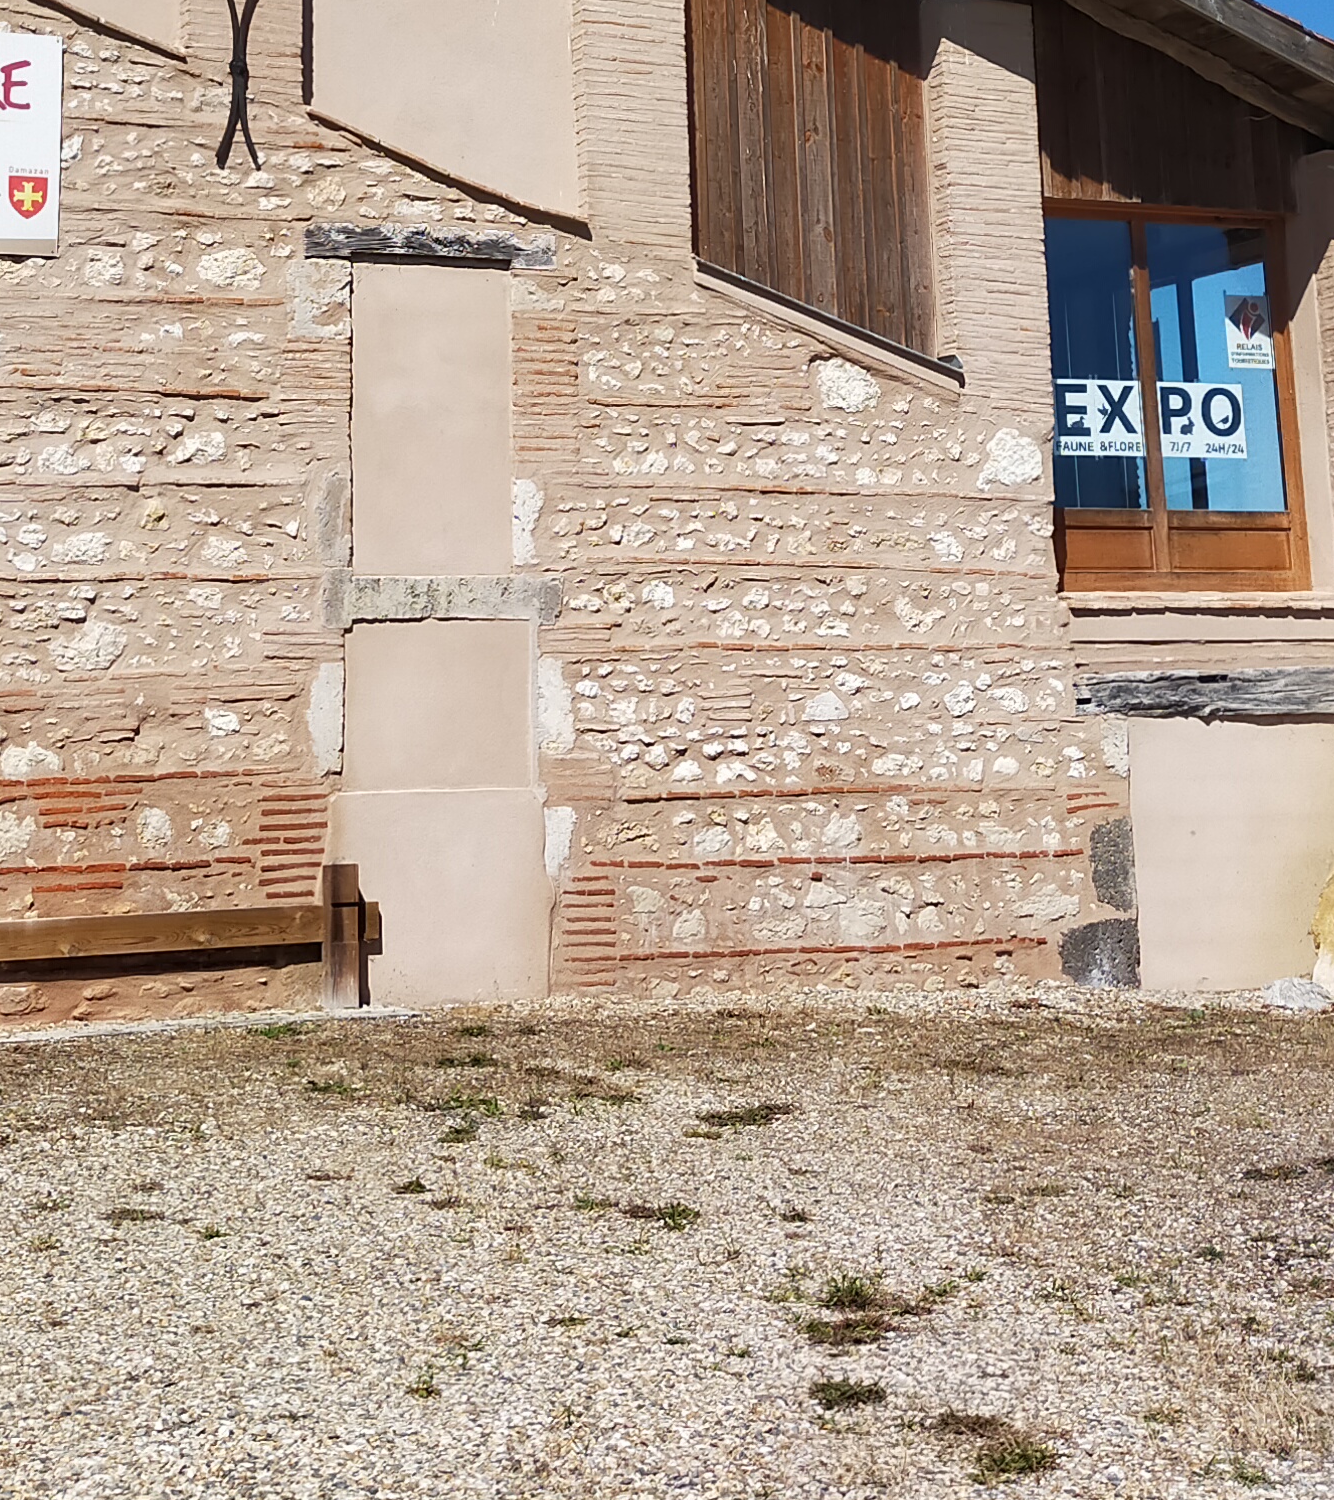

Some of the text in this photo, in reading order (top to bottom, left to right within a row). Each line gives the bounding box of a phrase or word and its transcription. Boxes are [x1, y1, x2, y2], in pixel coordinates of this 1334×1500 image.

[8, 165, 49, 175] Damazan
[1236, 343, 1263, 351] RELAIS
[1055, 383, 1241, 437] EXPO
[1056, 441, 1094, 452] FAUNE
[1205, 443, 1245, 455] 24H/24
